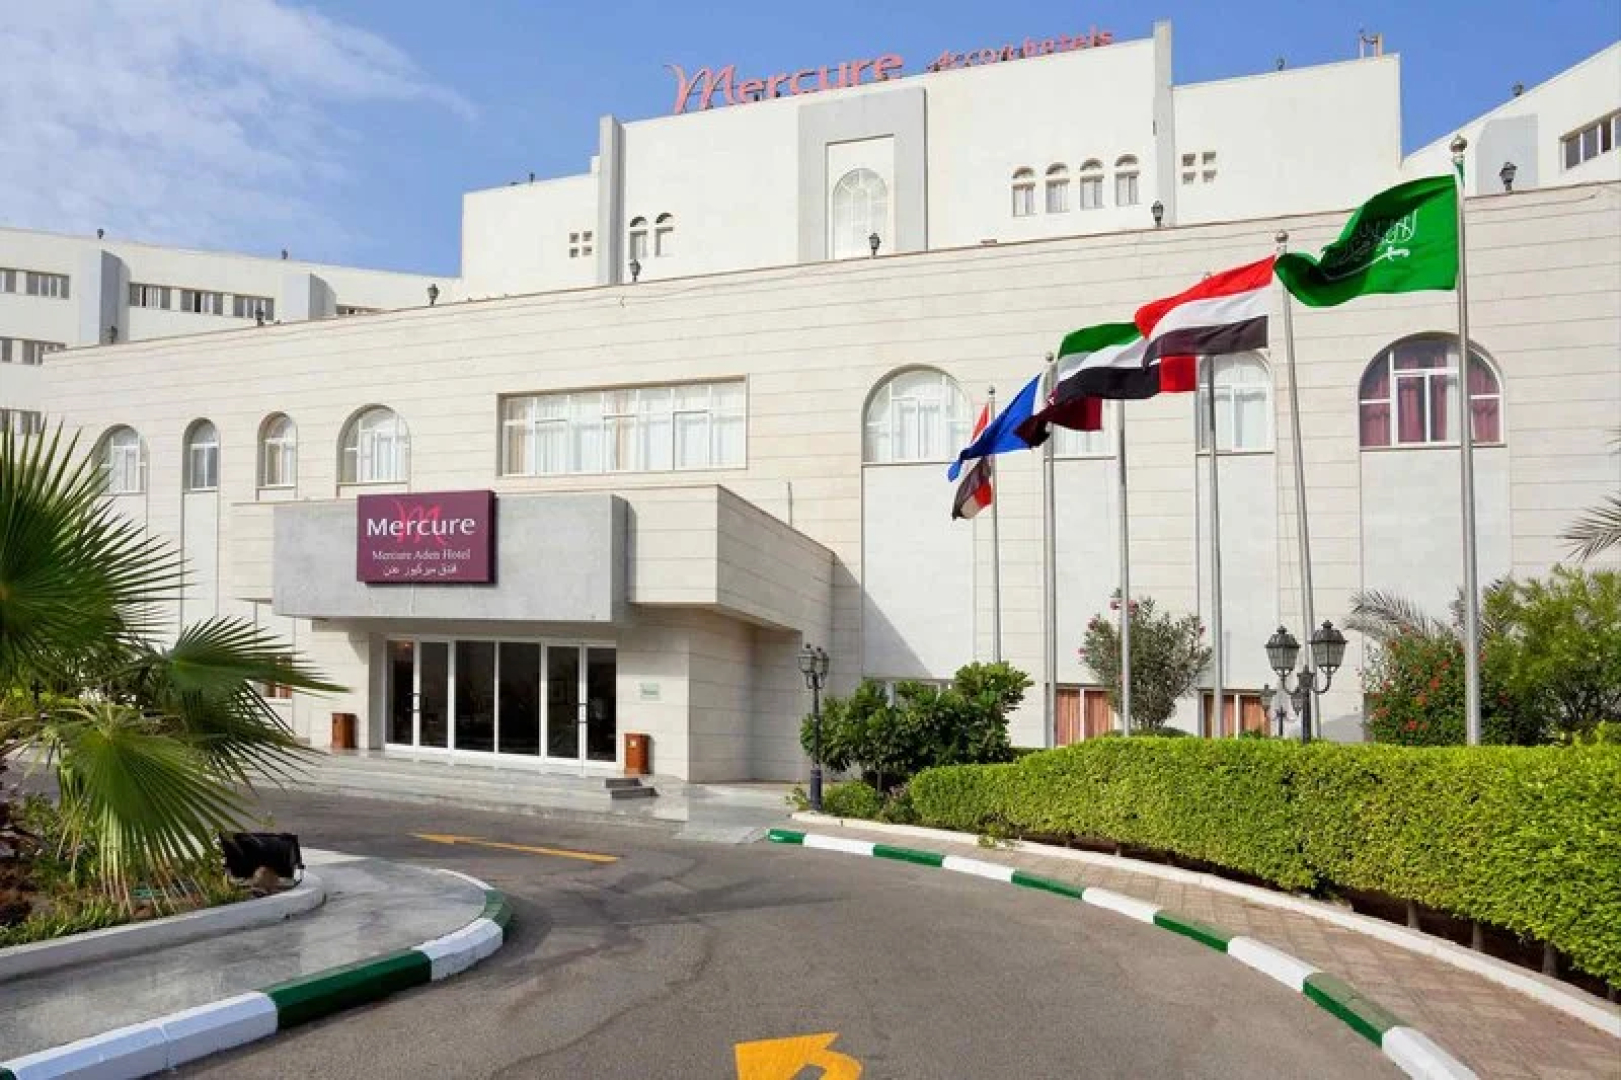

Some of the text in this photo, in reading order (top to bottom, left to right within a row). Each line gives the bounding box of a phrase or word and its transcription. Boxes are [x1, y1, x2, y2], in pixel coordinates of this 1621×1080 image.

[664, 53, 904, 115] Mercure
[367, 518, 475, 536] Mercure
[372, 549, 471, 560] Mercure Aden Hotel
